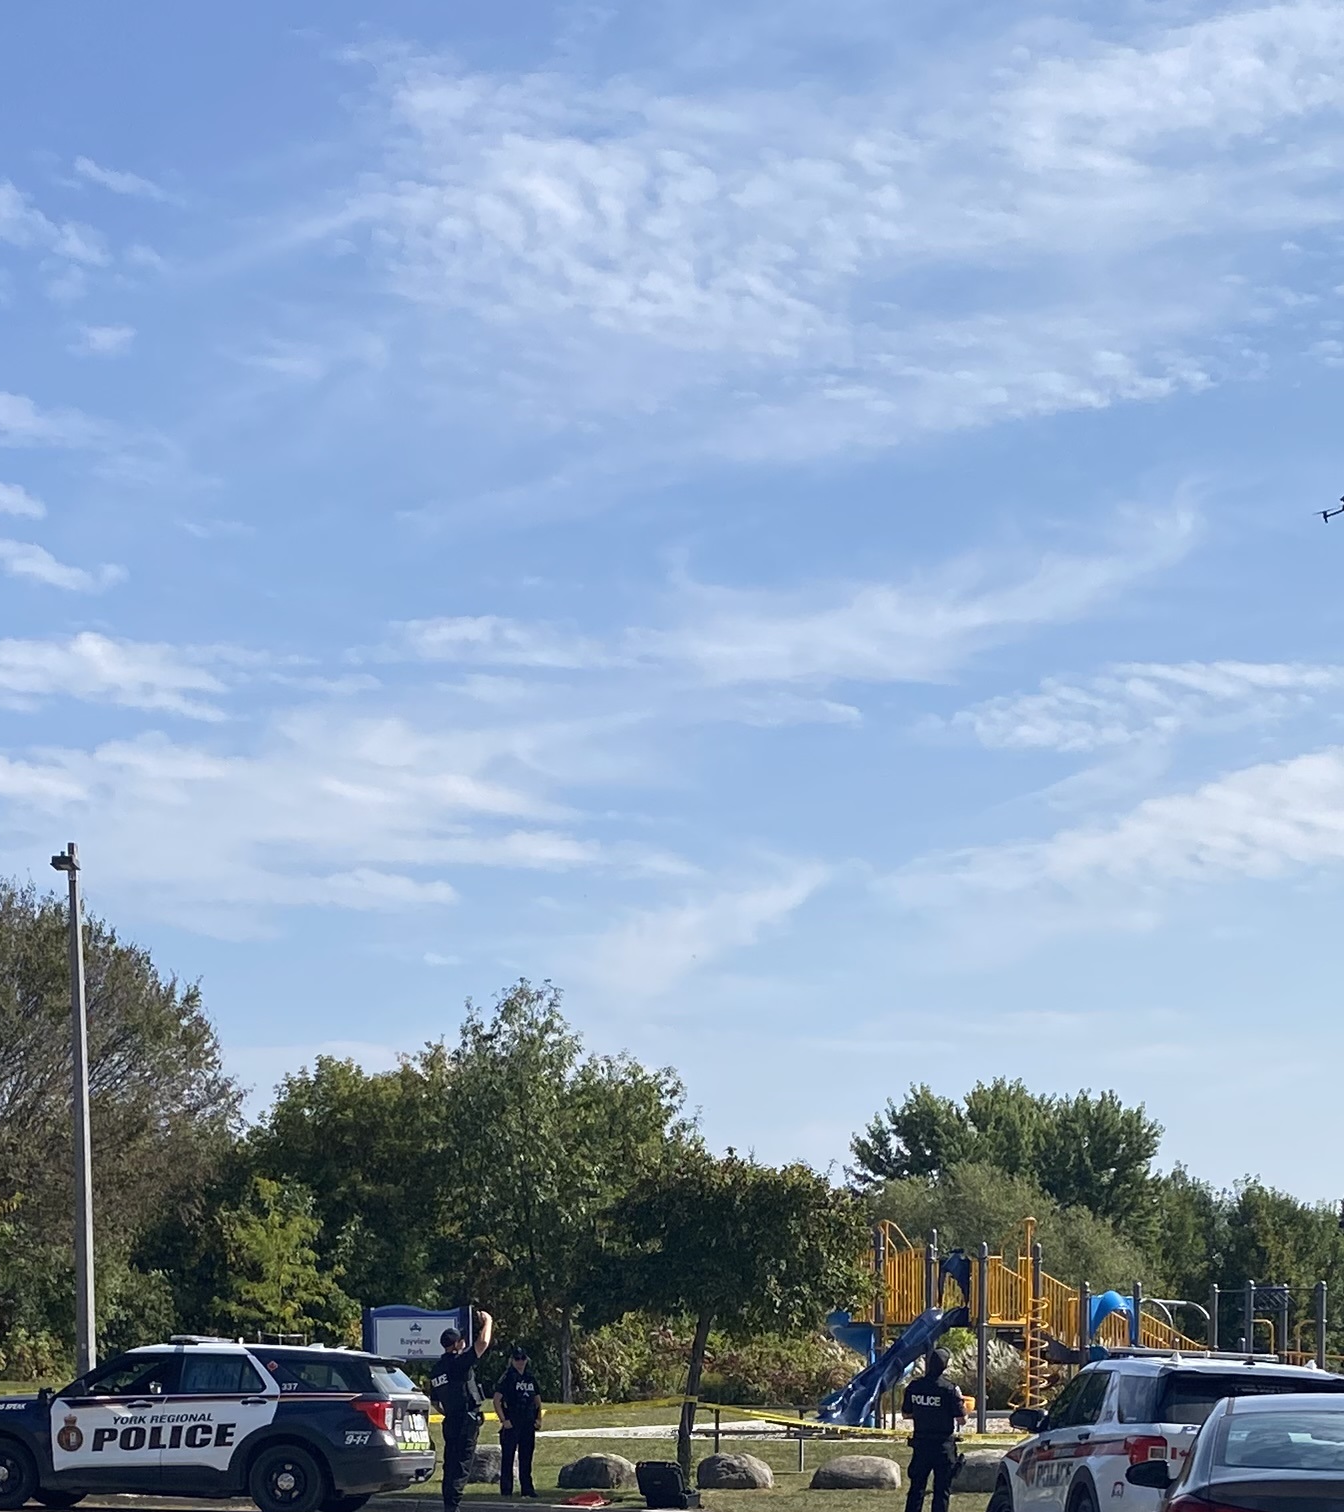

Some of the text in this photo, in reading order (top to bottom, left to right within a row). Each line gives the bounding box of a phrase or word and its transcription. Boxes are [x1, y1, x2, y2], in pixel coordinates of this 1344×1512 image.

[400, 1338, 431, 1346] Bayview
[281, 1382, 299, 1391] 337
[911, 1394, 942, 1407] POLICE
[113, 1413, 214, 1425] YORK REGIONAL
[91, 1423, 237, 1452] POLICE
[344, 1434, 370, 1445] 9-1-1
